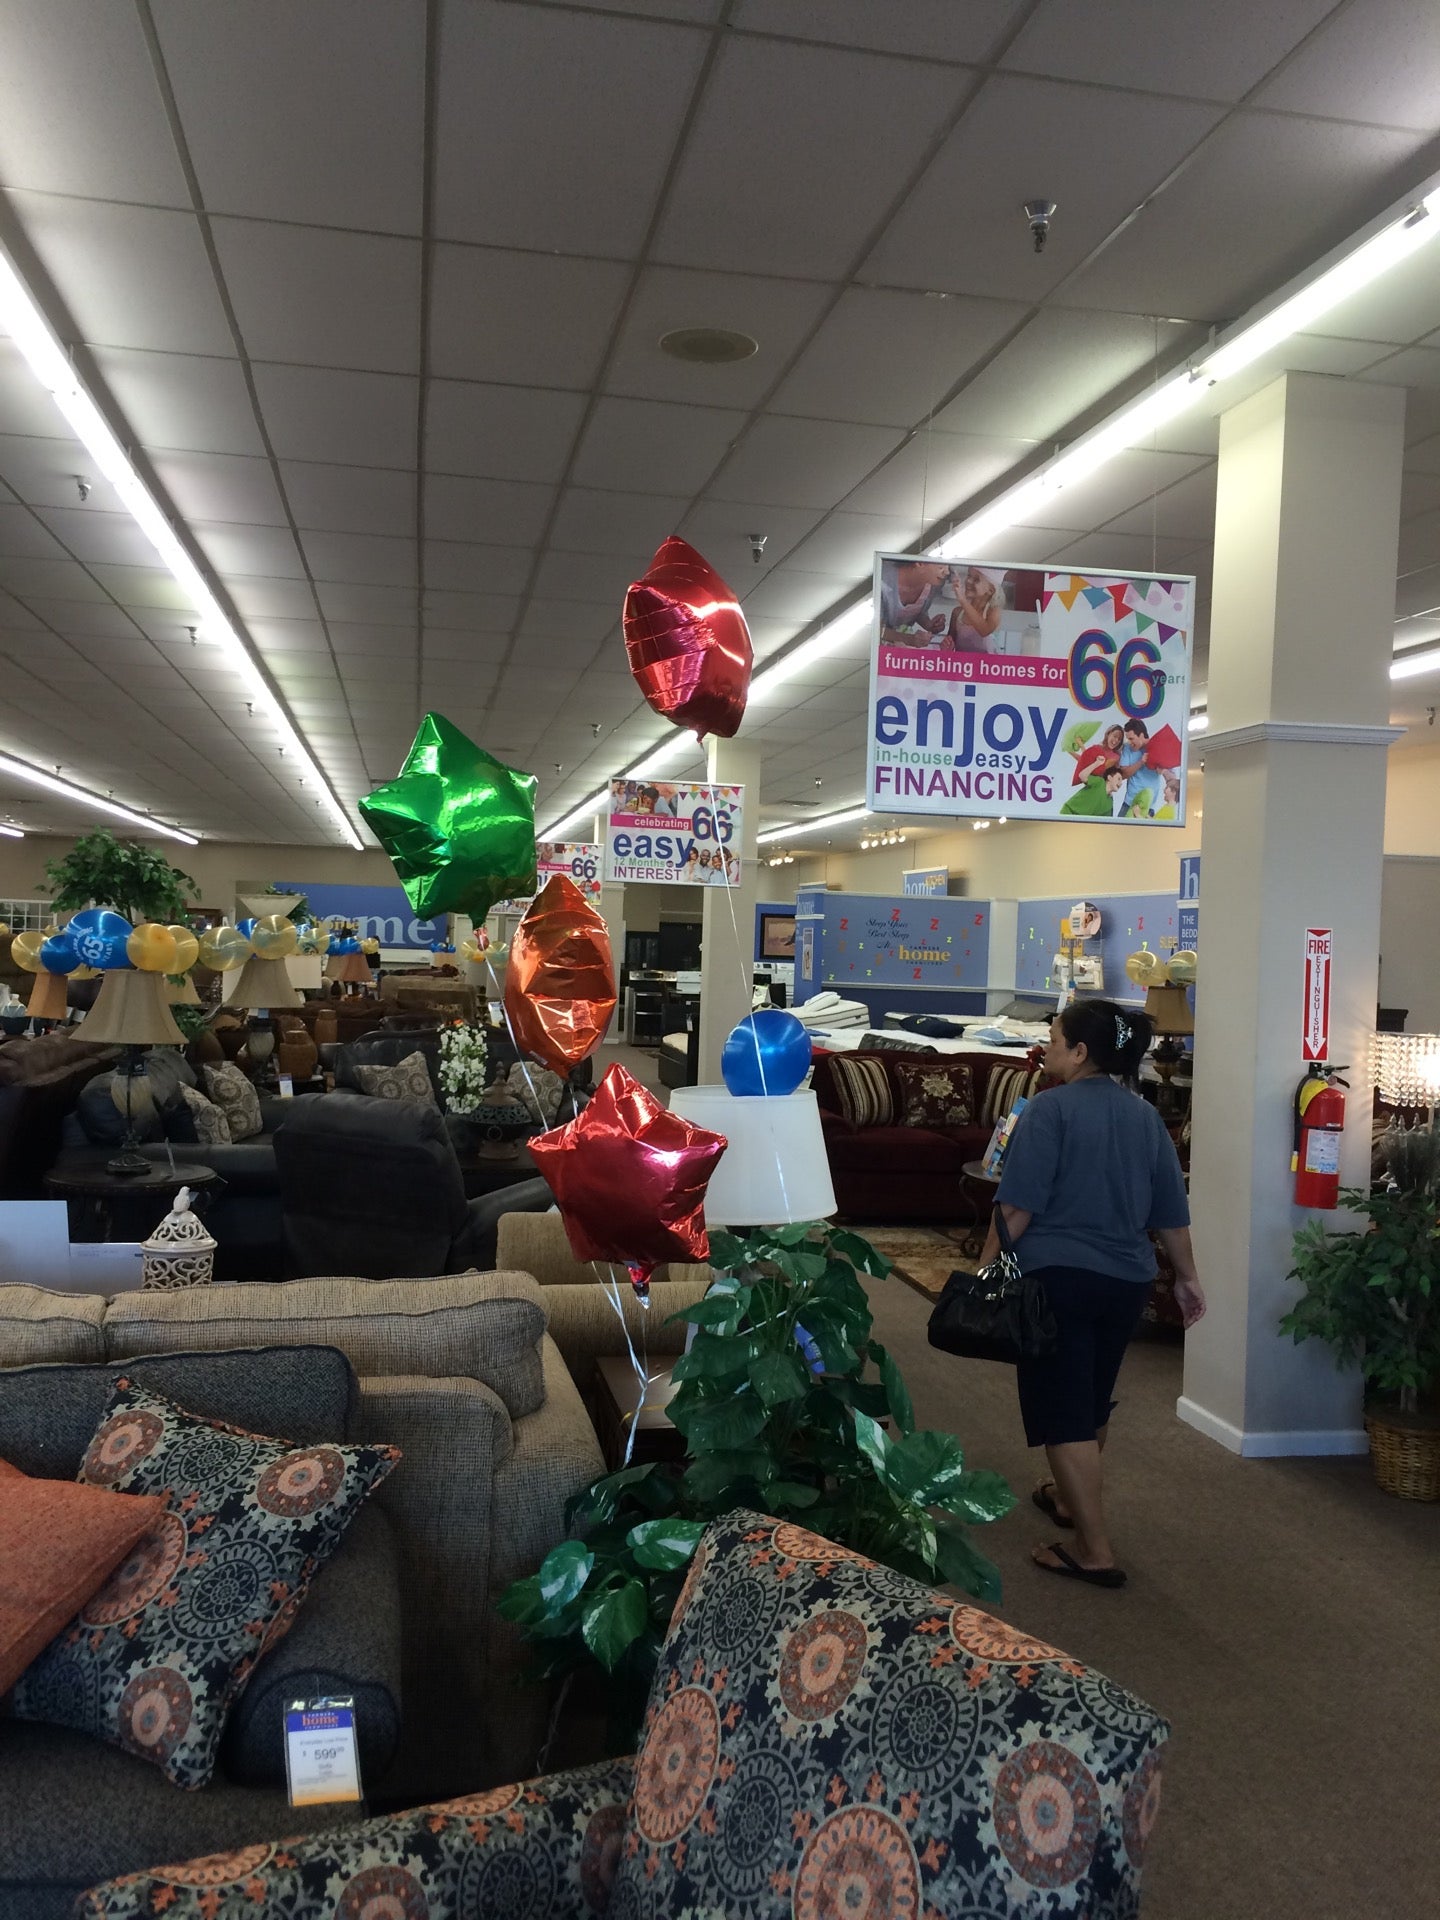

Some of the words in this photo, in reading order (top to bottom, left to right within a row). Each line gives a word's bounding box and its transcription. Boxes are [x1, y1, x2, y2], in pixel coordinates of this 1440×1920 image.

[885, 654, 973, 677] furnishing
[980, 663, 1036, 678] homes
[1042, 664, 1066, 680] for
[1068, 629, 1165, 718] 66
[876, 685, 1068, 771] enjoy
[876, 747, 952, 766] in-house
[975, 753, 1026, 773] easy
[634, 818, 689, 830] celebrating
[692, 806, 733, 843] 66
[613, 833, 695, 868] easy
[615, 857, 625, 866] 12
[629, 858, 665, 867] Months
[572, 857, 597, 879] 66
[614, 866, 682, 880] INTEREST
[322, 914, 437, 945] ome
[1182, 915, 1195, 925] THE
[1182, 928, 1198, 938] BEDD
[82, 936, 104, 960] 65
[899, 945, 952, 961] home
[1181, 941, 1197, 950] STOR
[1308, 940, 1330, 954] FIRE
[1313, 955, 1321, 1048] EXTINGUISHER
